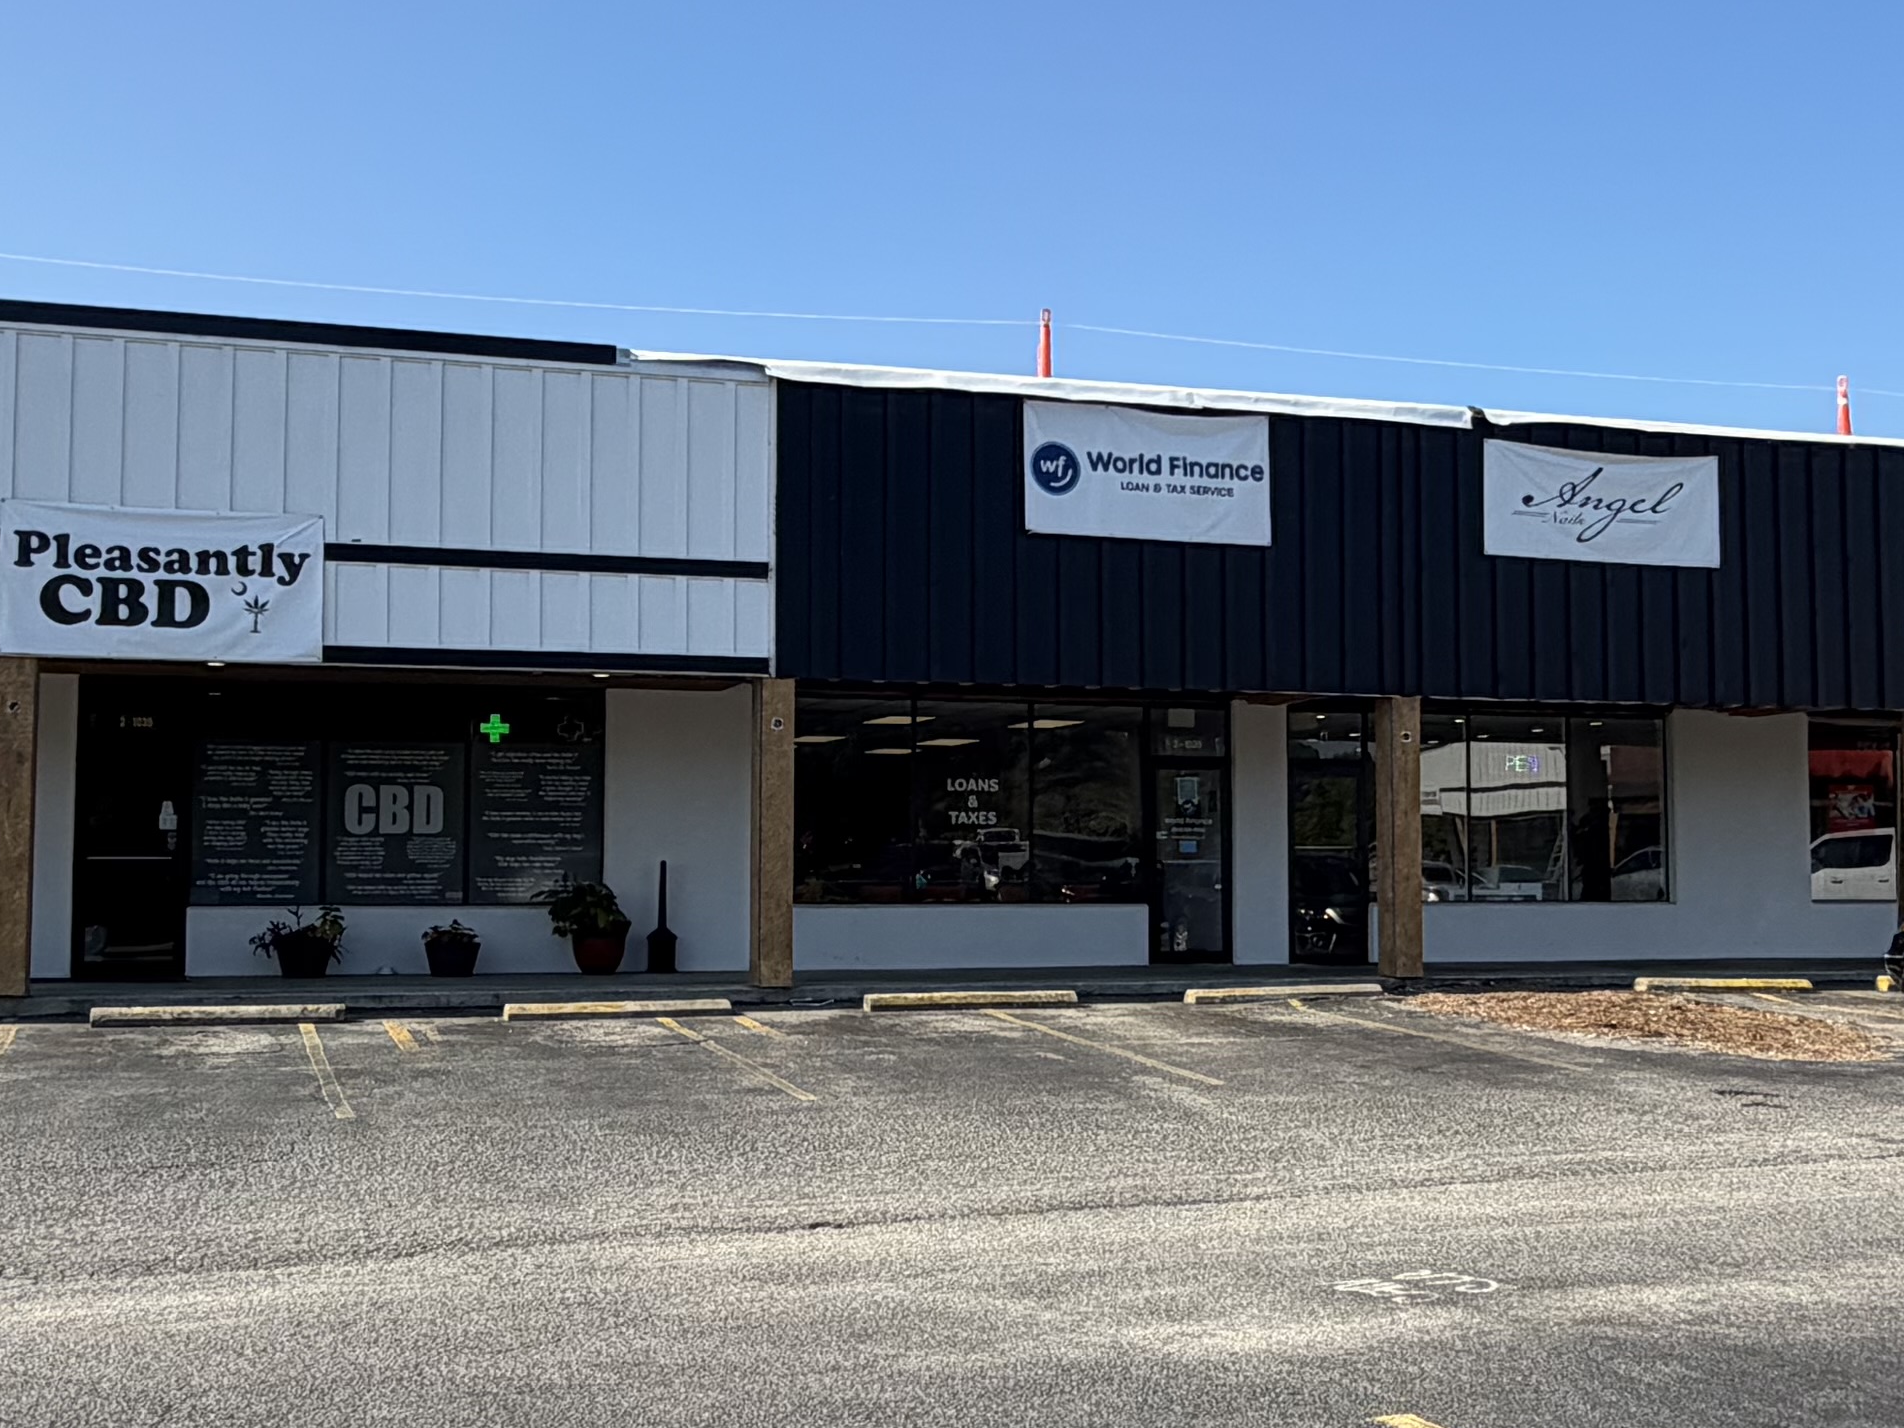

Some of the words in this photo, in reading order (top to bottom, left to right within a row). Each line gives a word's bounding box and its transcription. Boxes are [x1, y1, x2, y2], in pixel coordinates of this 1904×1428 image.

[1040, 455, 1067, 478] wf
[1086, 450, 1162, 476] World
[1168, 455, 1265, 483] Finance
[1120, 481, 1150, 493] LOAN
[1153, 483, 1162, 493] &
[1166, 484, 1187, 495] TAX
[1189, 485, 1234, 498] SERVICE
[1521, 467, 1684, 543] Angel
[13, 529, 312, 587] Pleasantly
[39, 573, 211, 629] CBD
[946, 778, 1000, 792] LOANS
[344, 783, 445, 835] CBD
[967, 794, 979, 808] &
[948, 811, 998, 825] TAXES
